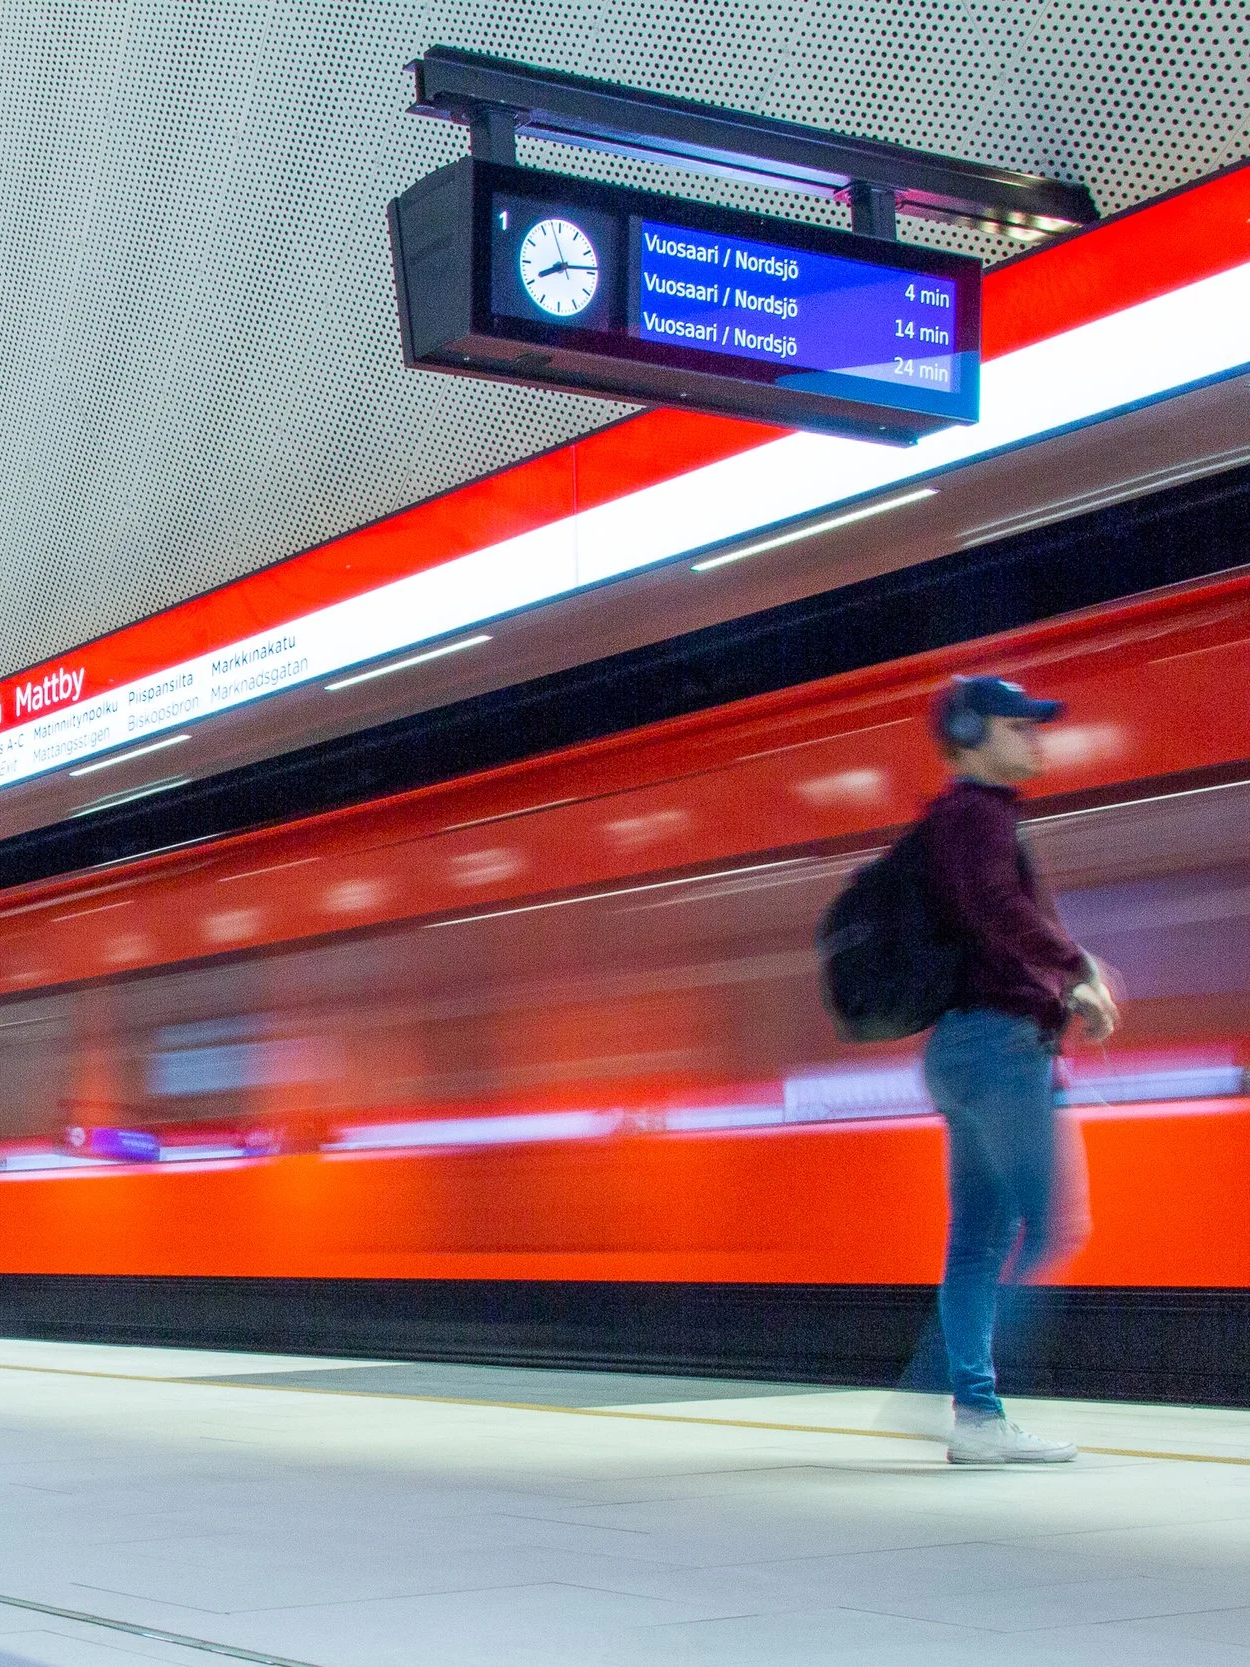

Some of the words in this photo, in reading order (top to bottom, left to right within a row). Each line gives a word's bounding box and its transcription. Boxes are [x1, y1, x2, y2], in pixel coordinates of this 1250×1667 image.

[498, 211, 508, 231] 1
[644, 232, 719, 266] Vuosaari
[723, 248, 730, 268] /
[735, 248, 799, 280] Nordsjö
[904, 283, 916, 302] 4
[920, 285, 950, 309] min
[644, 272, 718, 306] Vuosaari
[722, 287, 729, 307] /
[734, 287, 798, 318] Nordsjö
[895, 319, 915, 341] 14
[919, 322, 949, 346] min
[643, 311, 718, 344] Vuosaari
[721, 326, 729, 346] /
[734, 326, 797, 358] Nordsjö
[894, 356, 914, 377] 24
[918, 359, 949, 383] min
[15, 667, 85, 717] Mattby
[128, 672, 194, 706] Piispansilta
[211, 635, 296, 677] Markkinakatu
[210, 657, 308, 703] Marknadsgatan
